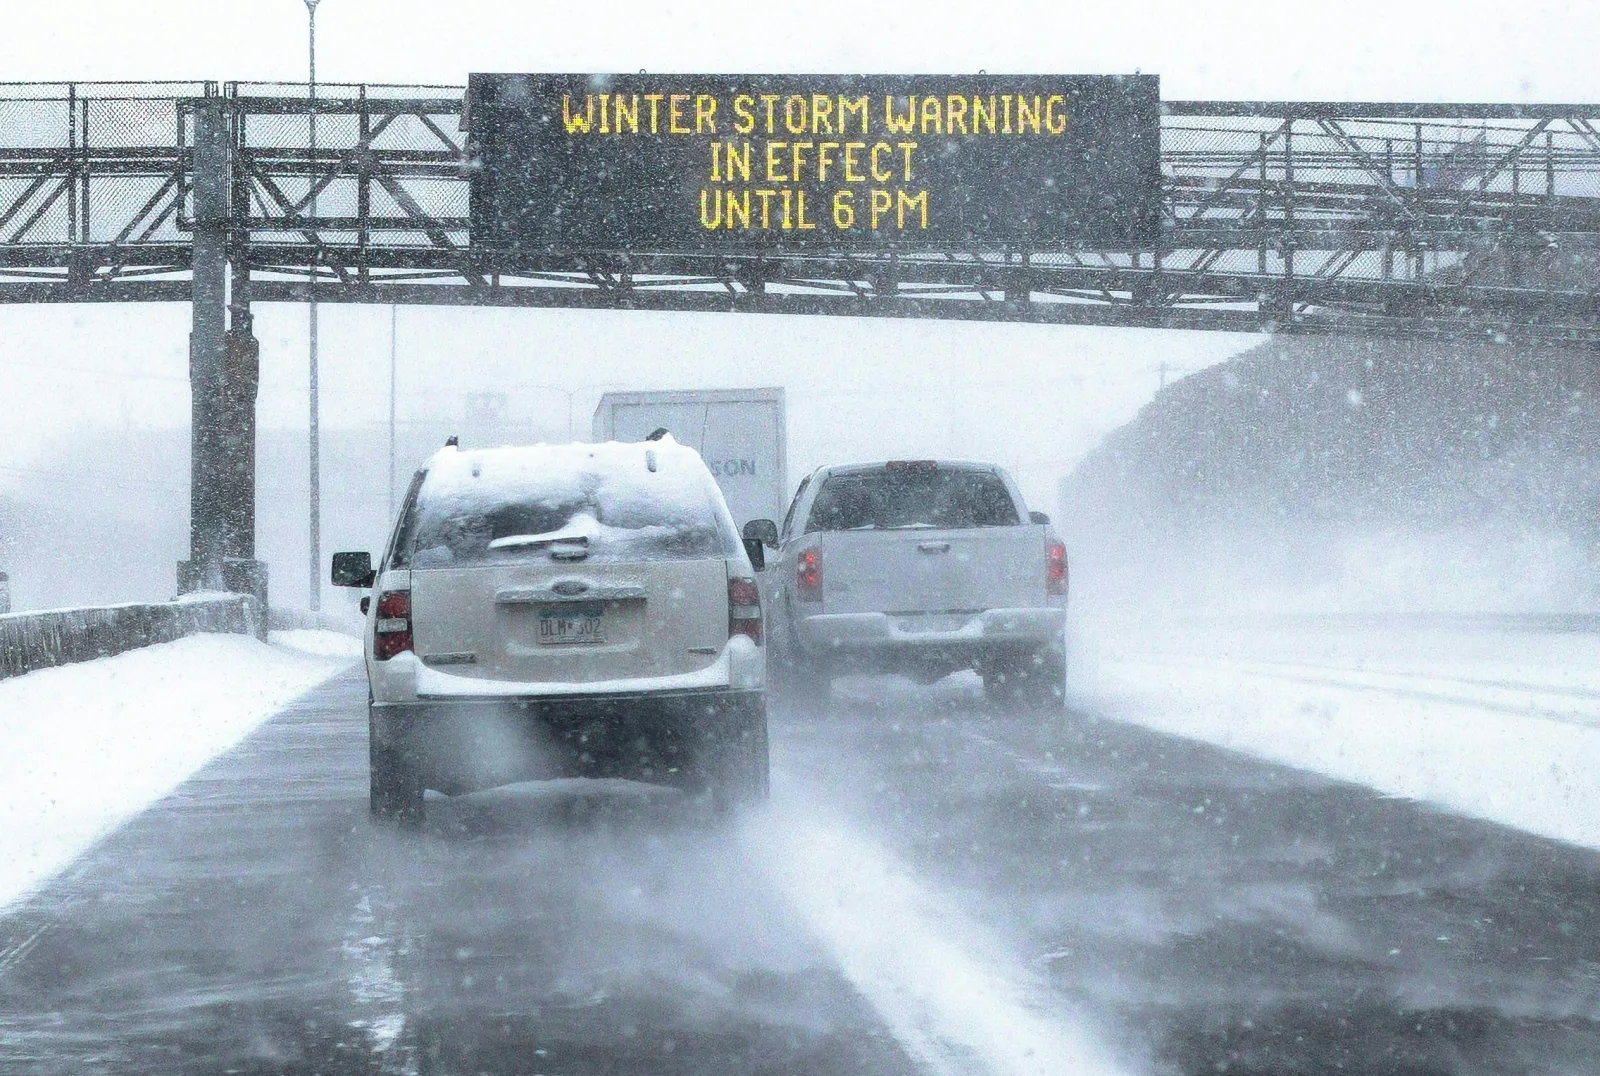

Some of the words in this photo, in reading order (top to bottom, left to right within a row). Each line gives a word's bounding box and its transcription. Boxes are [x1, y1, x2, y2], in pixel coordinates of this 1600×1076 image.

[563, 95, 718, 134] WINTER
[734, 95, 869, 134] STORM
[885, 95, 1067, 134] WARNING
[710, 142, 750, 182] IN
[767, 142, 918, 182] EFFECT
[700, 190, 815, 230] UNTIL
[832, 190, 855, 230] 6
[870, 190, 928, 230] PM
